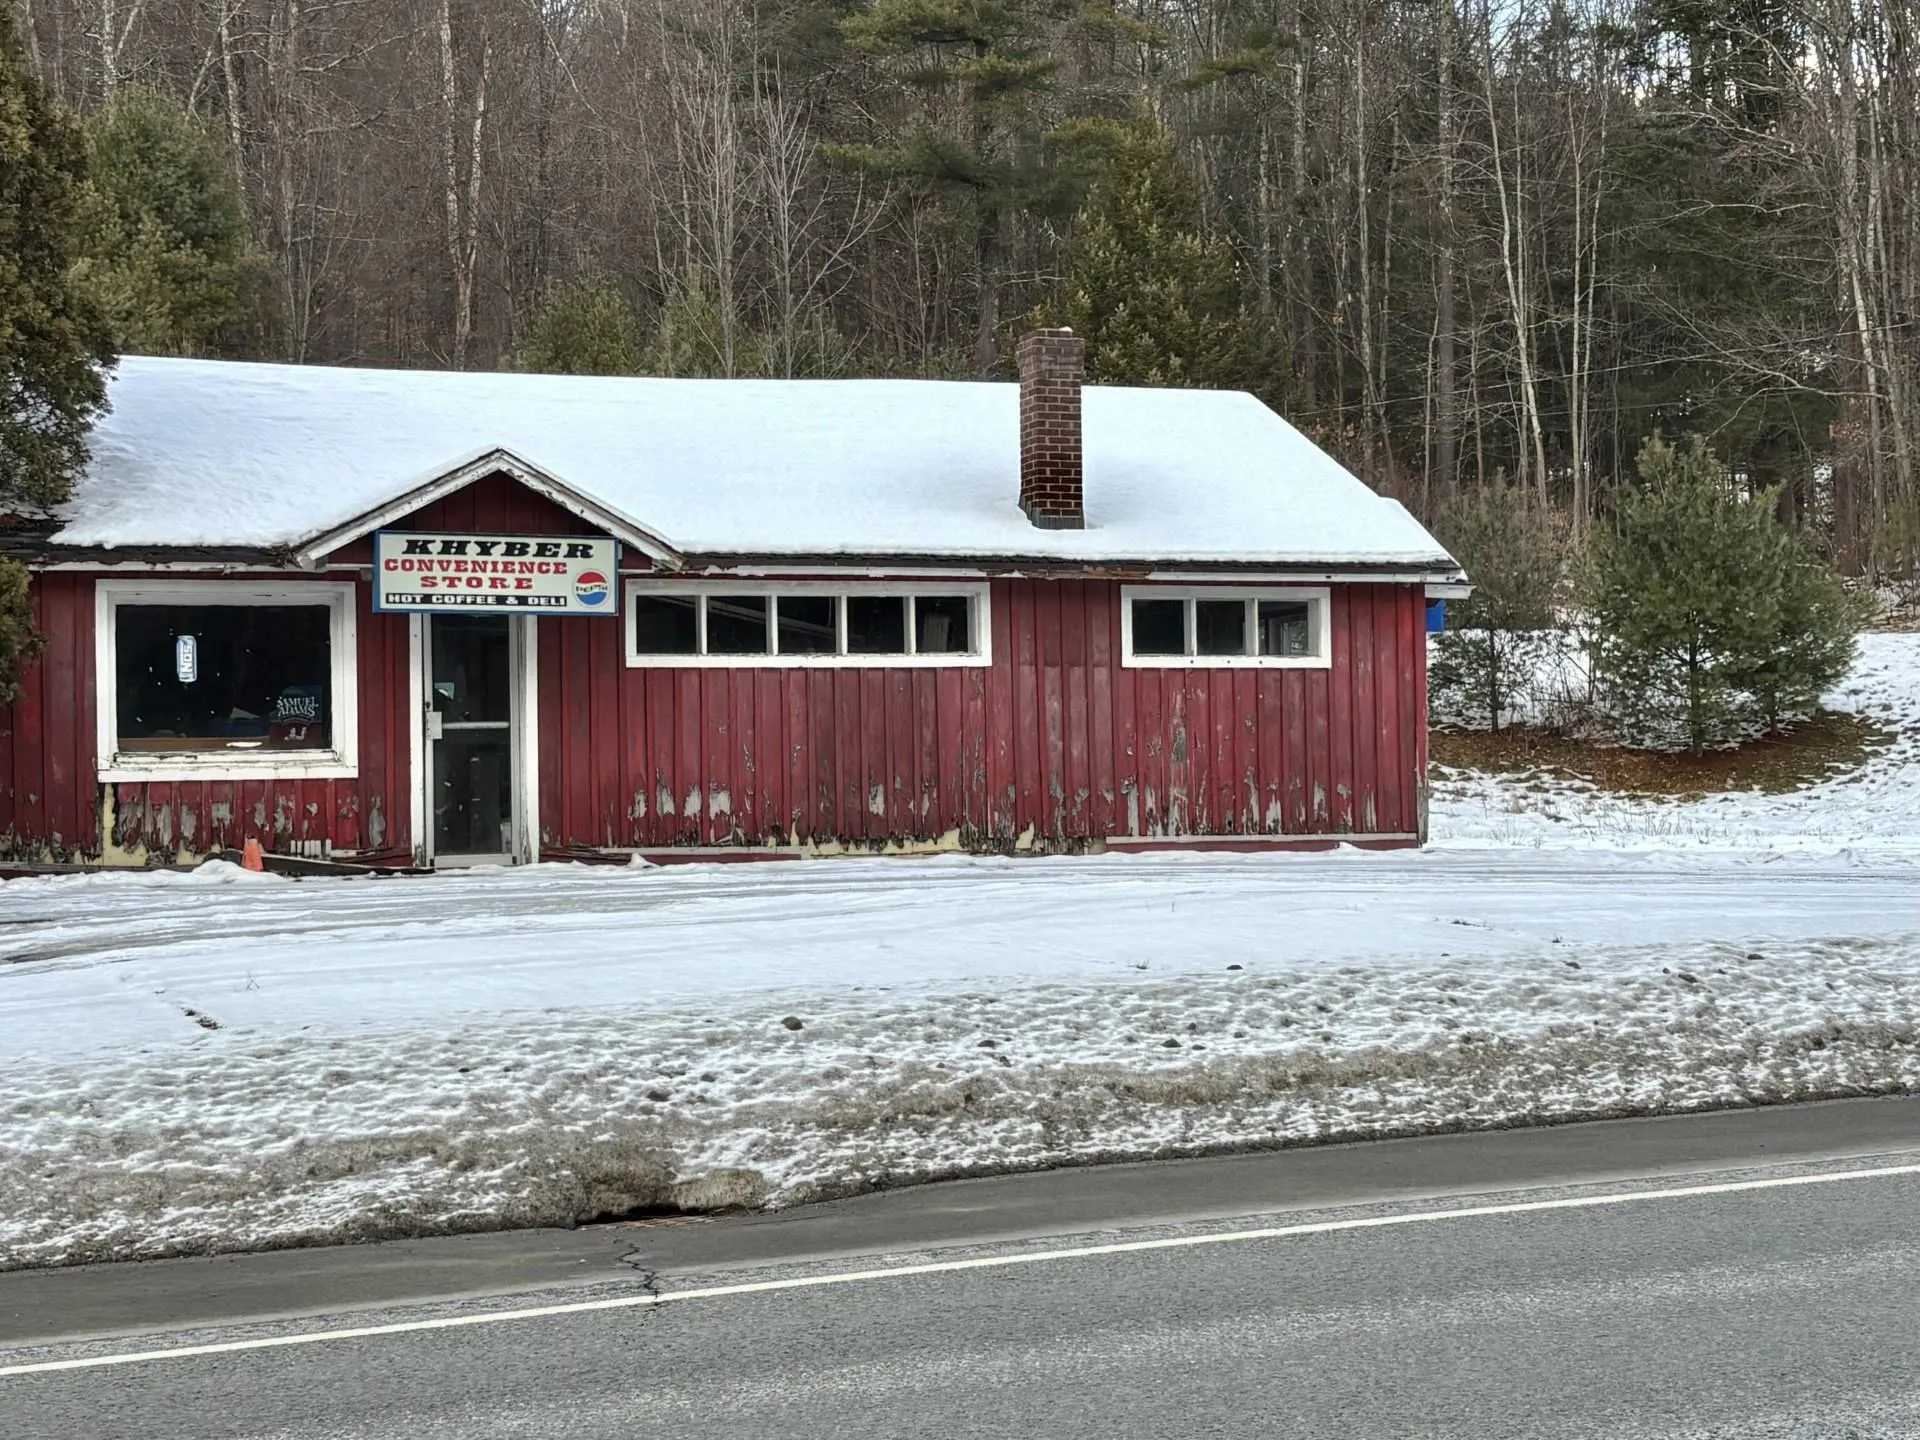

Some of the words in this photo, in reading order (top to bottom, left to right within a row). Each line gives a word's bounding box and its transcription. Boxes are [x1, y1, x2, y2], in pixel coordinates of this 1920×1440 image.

[401, 539, 594, 559] KHYBER
[384, 558, 568, 575] CONVENIENCE
[420, 575, 533, 590] STORE
[388, 594, 424, 603] HOT
[431, 595, 497, 605] COFFEE
[505, 596, 519, 605] &
[527, 597, 566, 606] DELI
[180, 645, 193, 673] NOS
